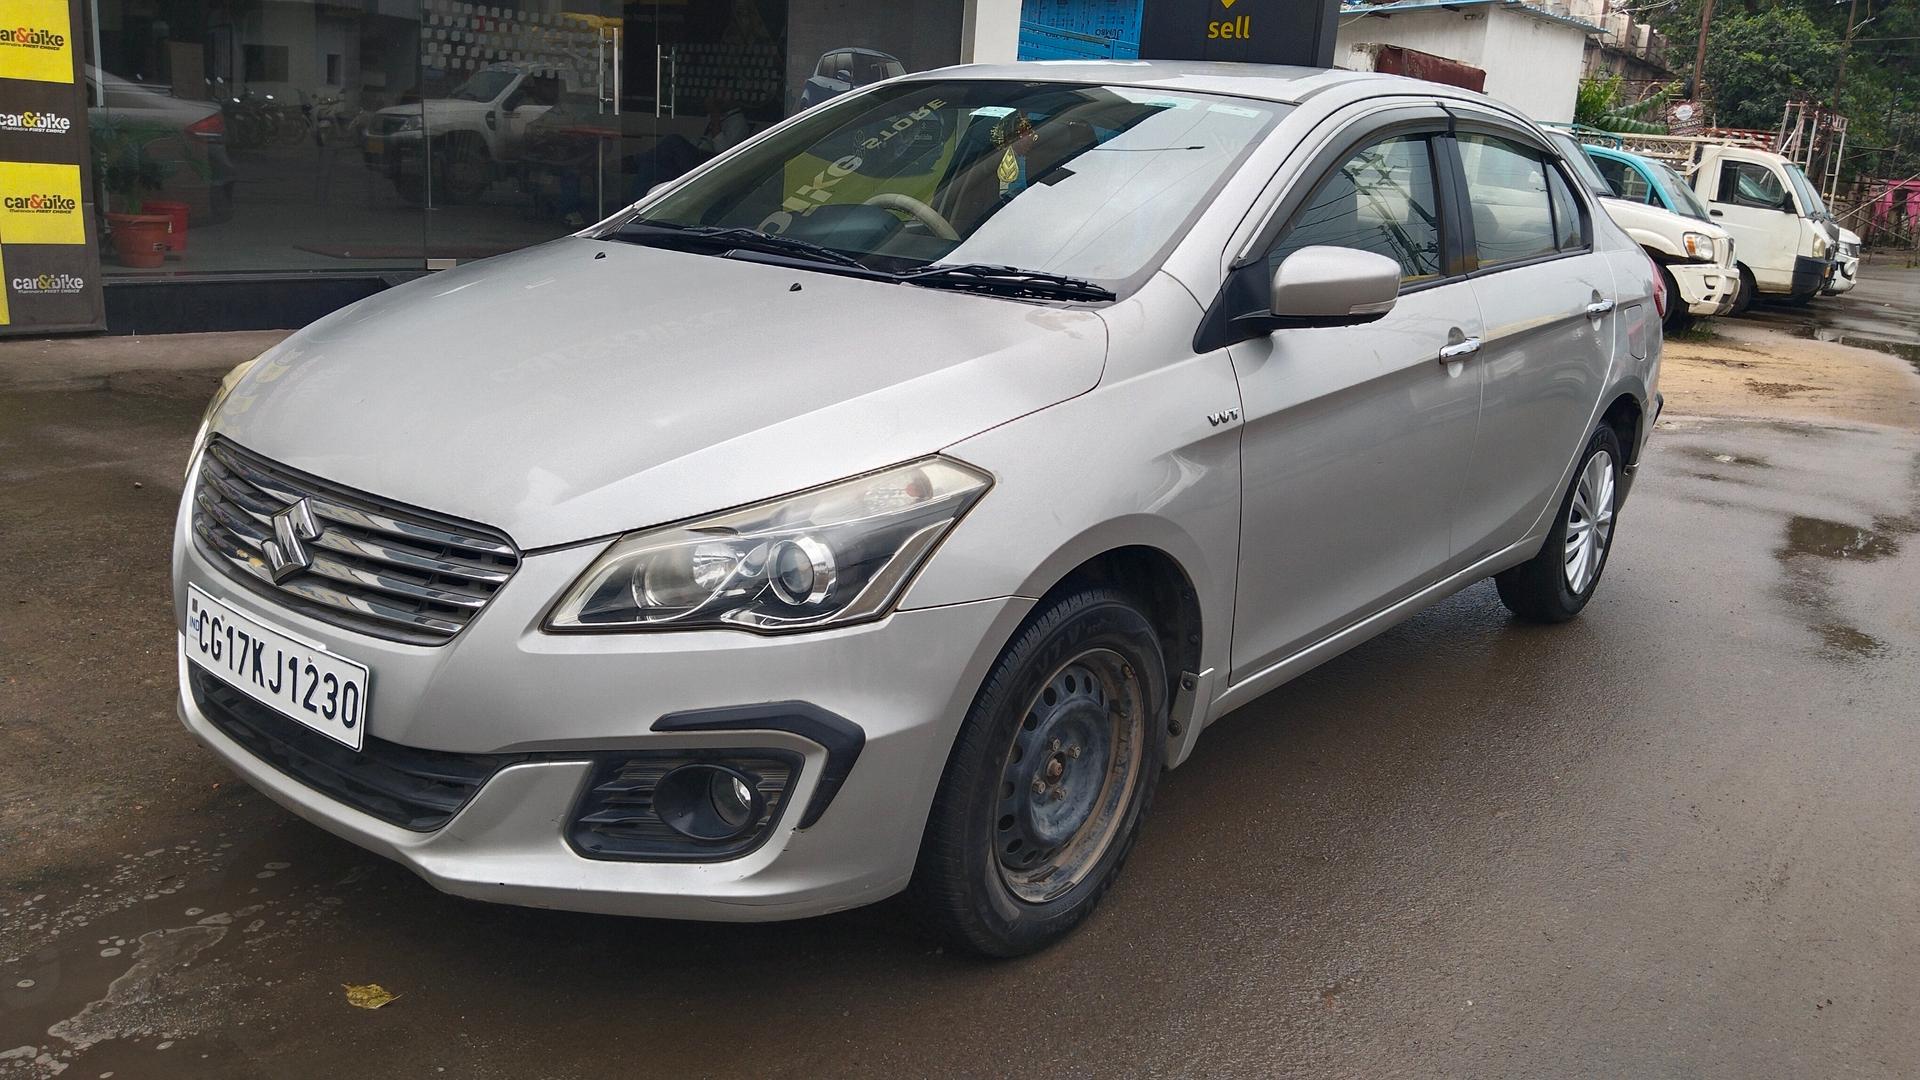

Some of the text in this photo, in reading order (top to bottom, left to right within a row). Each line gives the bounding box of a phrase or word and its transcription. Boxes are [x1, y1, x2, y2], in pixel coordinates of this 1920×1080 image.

[1208, 15, 1250, 39] sell
[0, 27, 64, 46] ar&bike
[0, 111, 70, 129] car&bike
[4, 194, 75, 209] car&bike
[13, 274, 83, 289] car&bike
[1207, 407, 1239, 427] VVT
[190, 616, 200, 632] IND
[199, 609, 359, 729] CG17KJ1230
